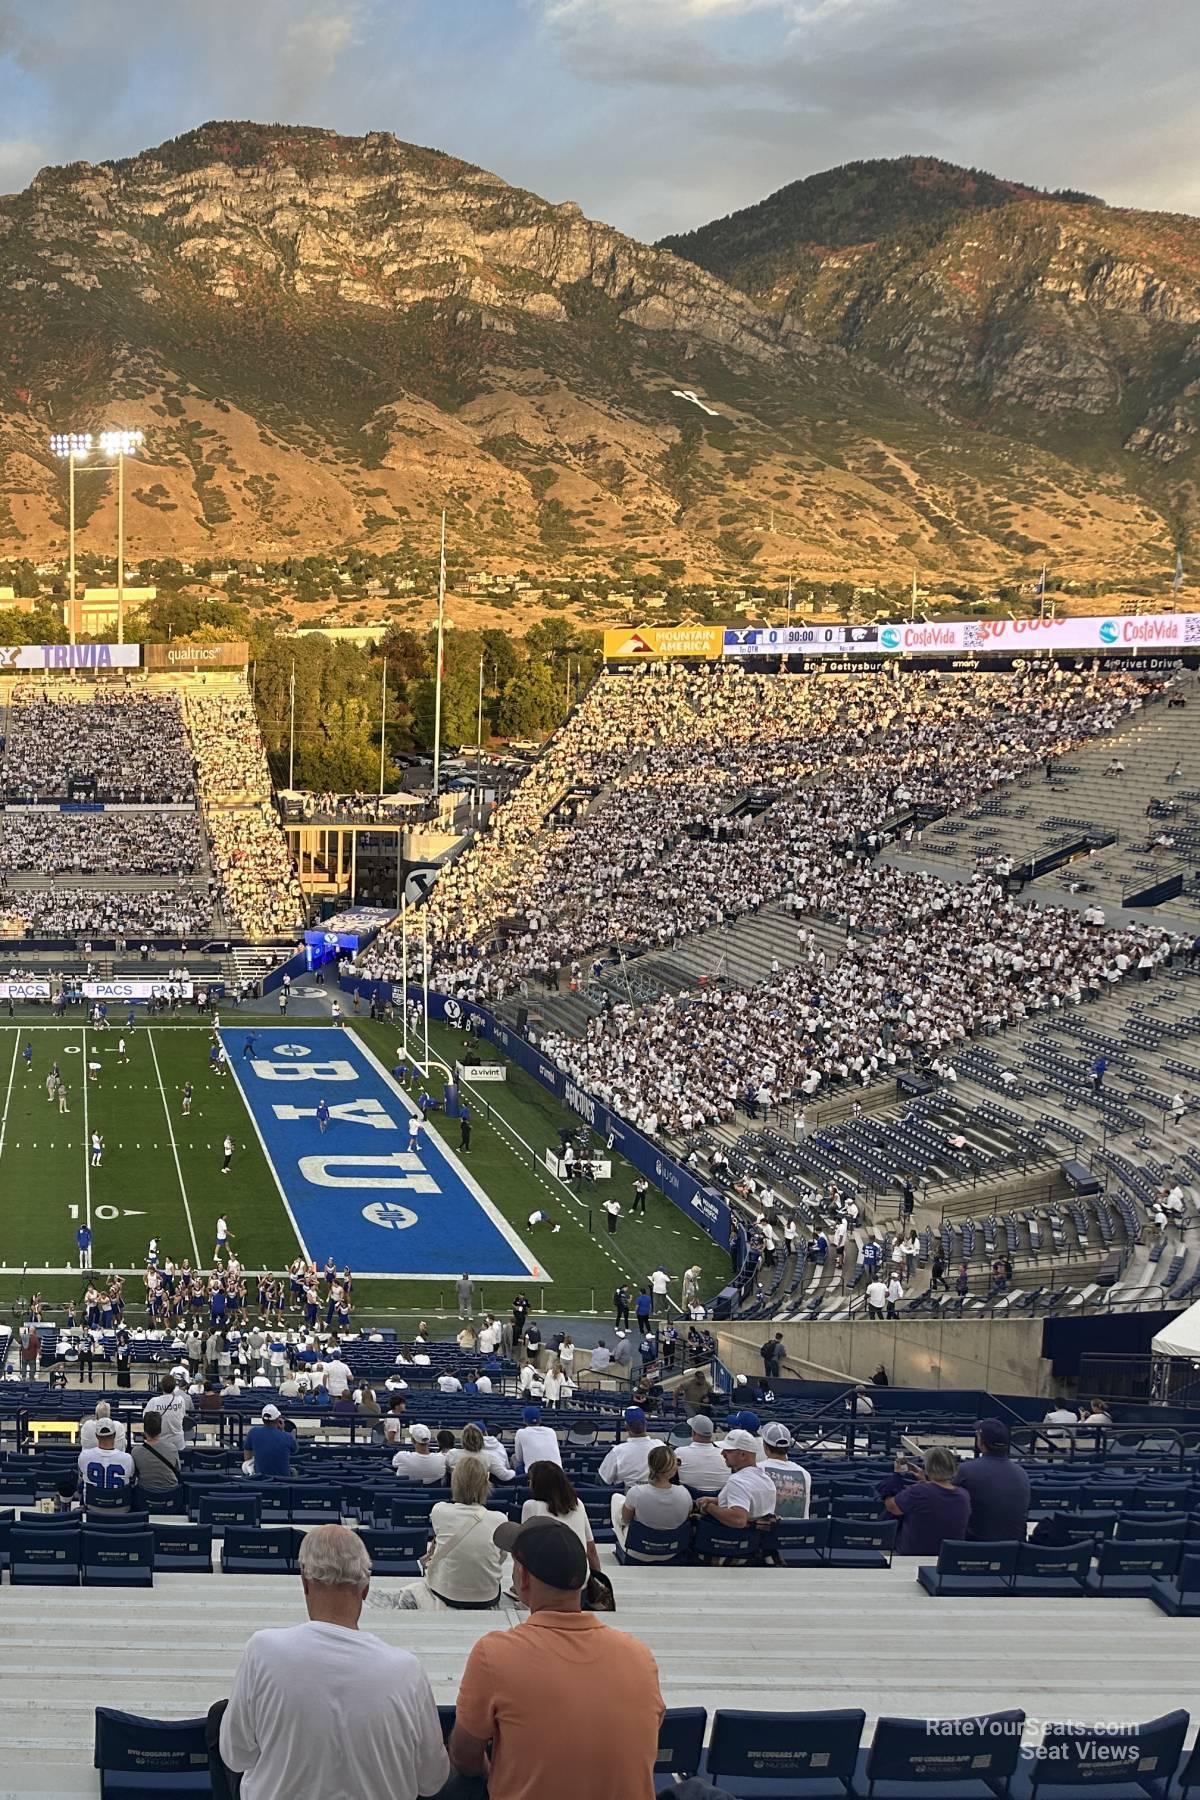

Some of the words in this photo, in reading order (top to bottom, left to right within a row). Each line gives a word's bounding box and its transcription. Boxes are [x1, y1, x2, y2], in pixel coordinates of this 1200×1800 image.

[655, 630, 715, 642] MOUNTAIN
[769, 631, 777, 643] 0
[788, 631, 814, 643] 90:00
[824, 629, 833, 642] 0
[659, 641, 711, 652] AMERICA
[40, 645, 112, 667] TRIVIA
[803, 662, 828, 671] 807
[952, 660, 980, 669] smarty
[8, 985, 44, 996] PACS
[96, 985, 132, 995] PACS
[478, 1068, 500, 1076] vivint
[250, 1060, 442, 1193] BYU
[69, 1204, 120, 1220] 10
[864, 1248, 874, 1258] 92
[87, 1462, 126, 1488] 96
